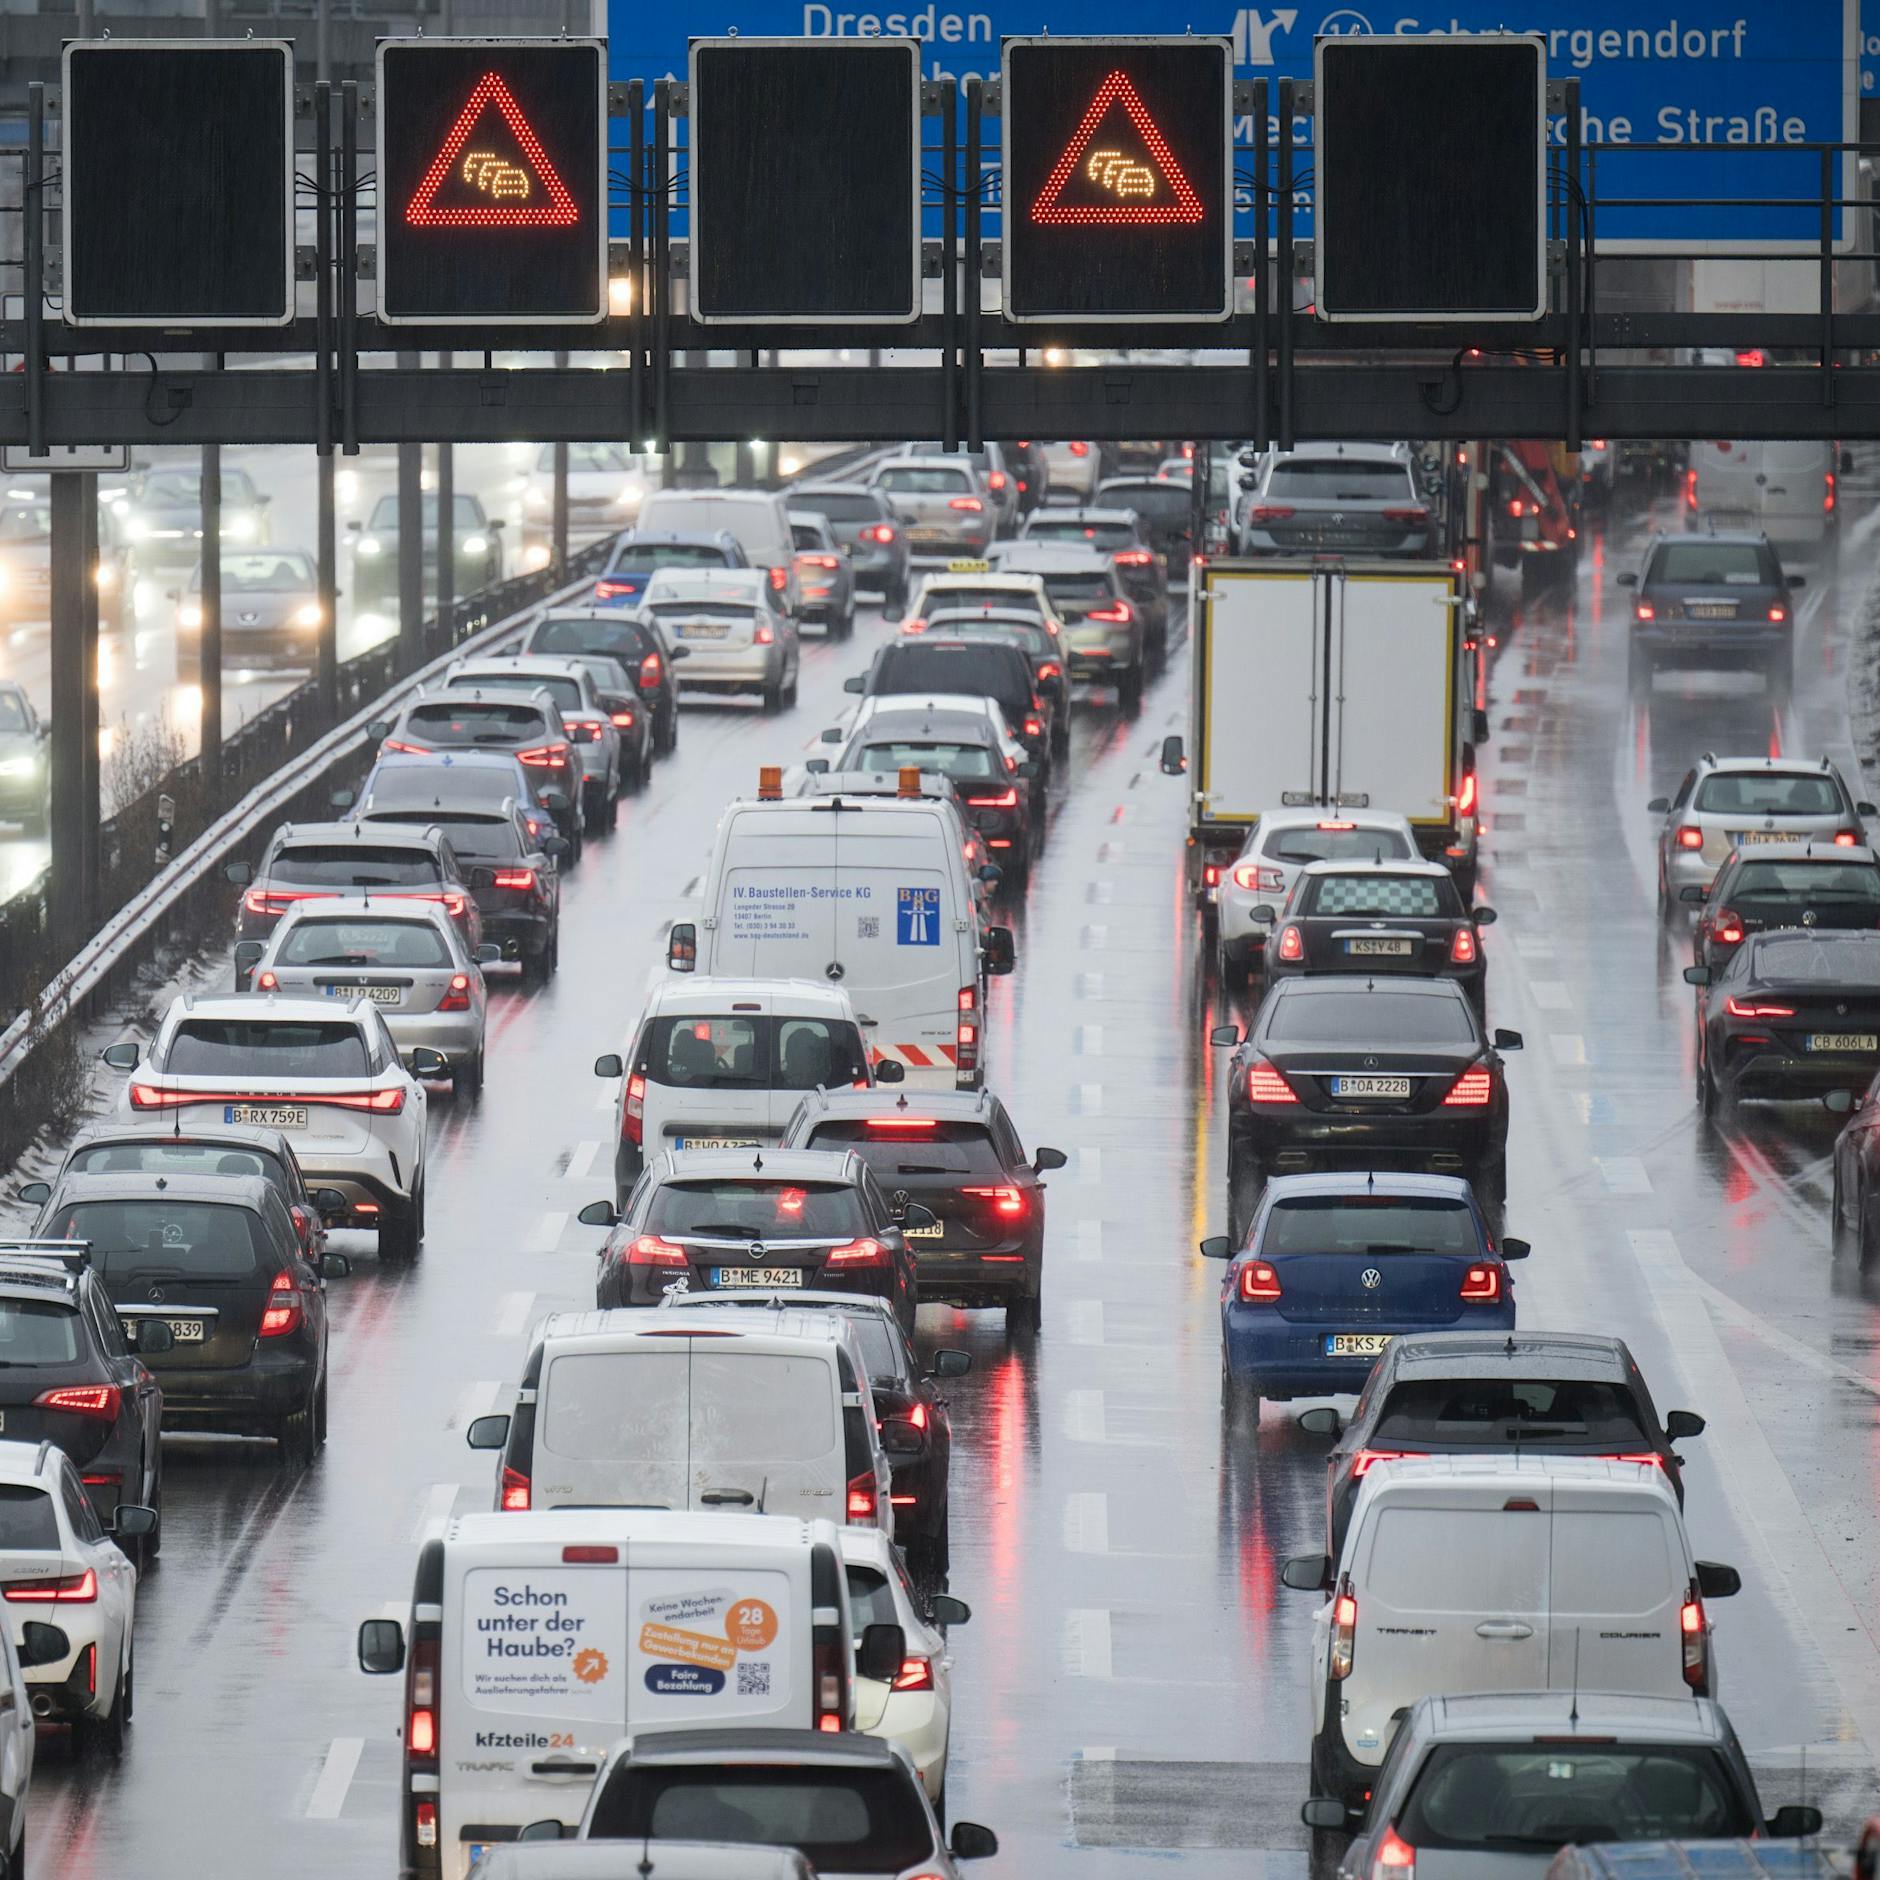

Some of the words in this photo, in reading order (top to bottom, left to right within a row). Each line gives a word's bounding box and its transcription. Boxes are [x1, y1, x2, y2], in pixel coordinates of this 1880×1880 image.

[803, 3, 992, 42] Dresden
[1656, 106, 1807, 143] Straße
[749, 887, 852, 898] Baustellen-Service
[856, 887, 871, 898] KG
[368, 987, 398, 1001] 4209
[1814, 1036, 1830, 1048] CB
[1341, 1080, 1349, 1092] B
[1377, 1080, 1408, 1092] 2228
[233, 1110, 241, 1123] B
[250, 1110, 267, 1123] RX
[270, 1110, 305, 1123] 759E
[721, 1269, 730, 1283] B
[740, 1270, 759, 1283] ME
[764, 1270, 800, 1284] 9421
[168, 1322, 202, 1337] 839
[1335, 1337, 1345, 1351] B
[1355, 1337, 1374, 1351] KS
[493, 1585, 567, 1606] Schon
[649, 1602, 679, 1613] Keine
[664, 1607, 715, 1622] endarbeit
[477, 1614, 539, 1632] unter
[545, 1611, 585, 1632] der
[738, 1607, 764, 1625] 28
[644, 1626, 699, 1650] Zustellung
[741, 1626, 761, 1636] Tage
[1376, 1627, 1437, 1636] TRANSIT
[487, 1636, 576, 1657] Haube?
[644, 1639, 731, 1667] Gewerbekunden
[474, 1674, 492, 1683] Wir
[494, 1674, 527, 1683] suchen
[530, 1673, 550, 1683] dich
[552, 1673, 567, 1683] als
[671, 1670, 699, 1680] Faire
[474, 1686, 569, 1696] Auslieferungsfahrer
[657, 1680, 713, 1693] Bezahlung
[475, 1732, 575, 1748] kfzteile24
